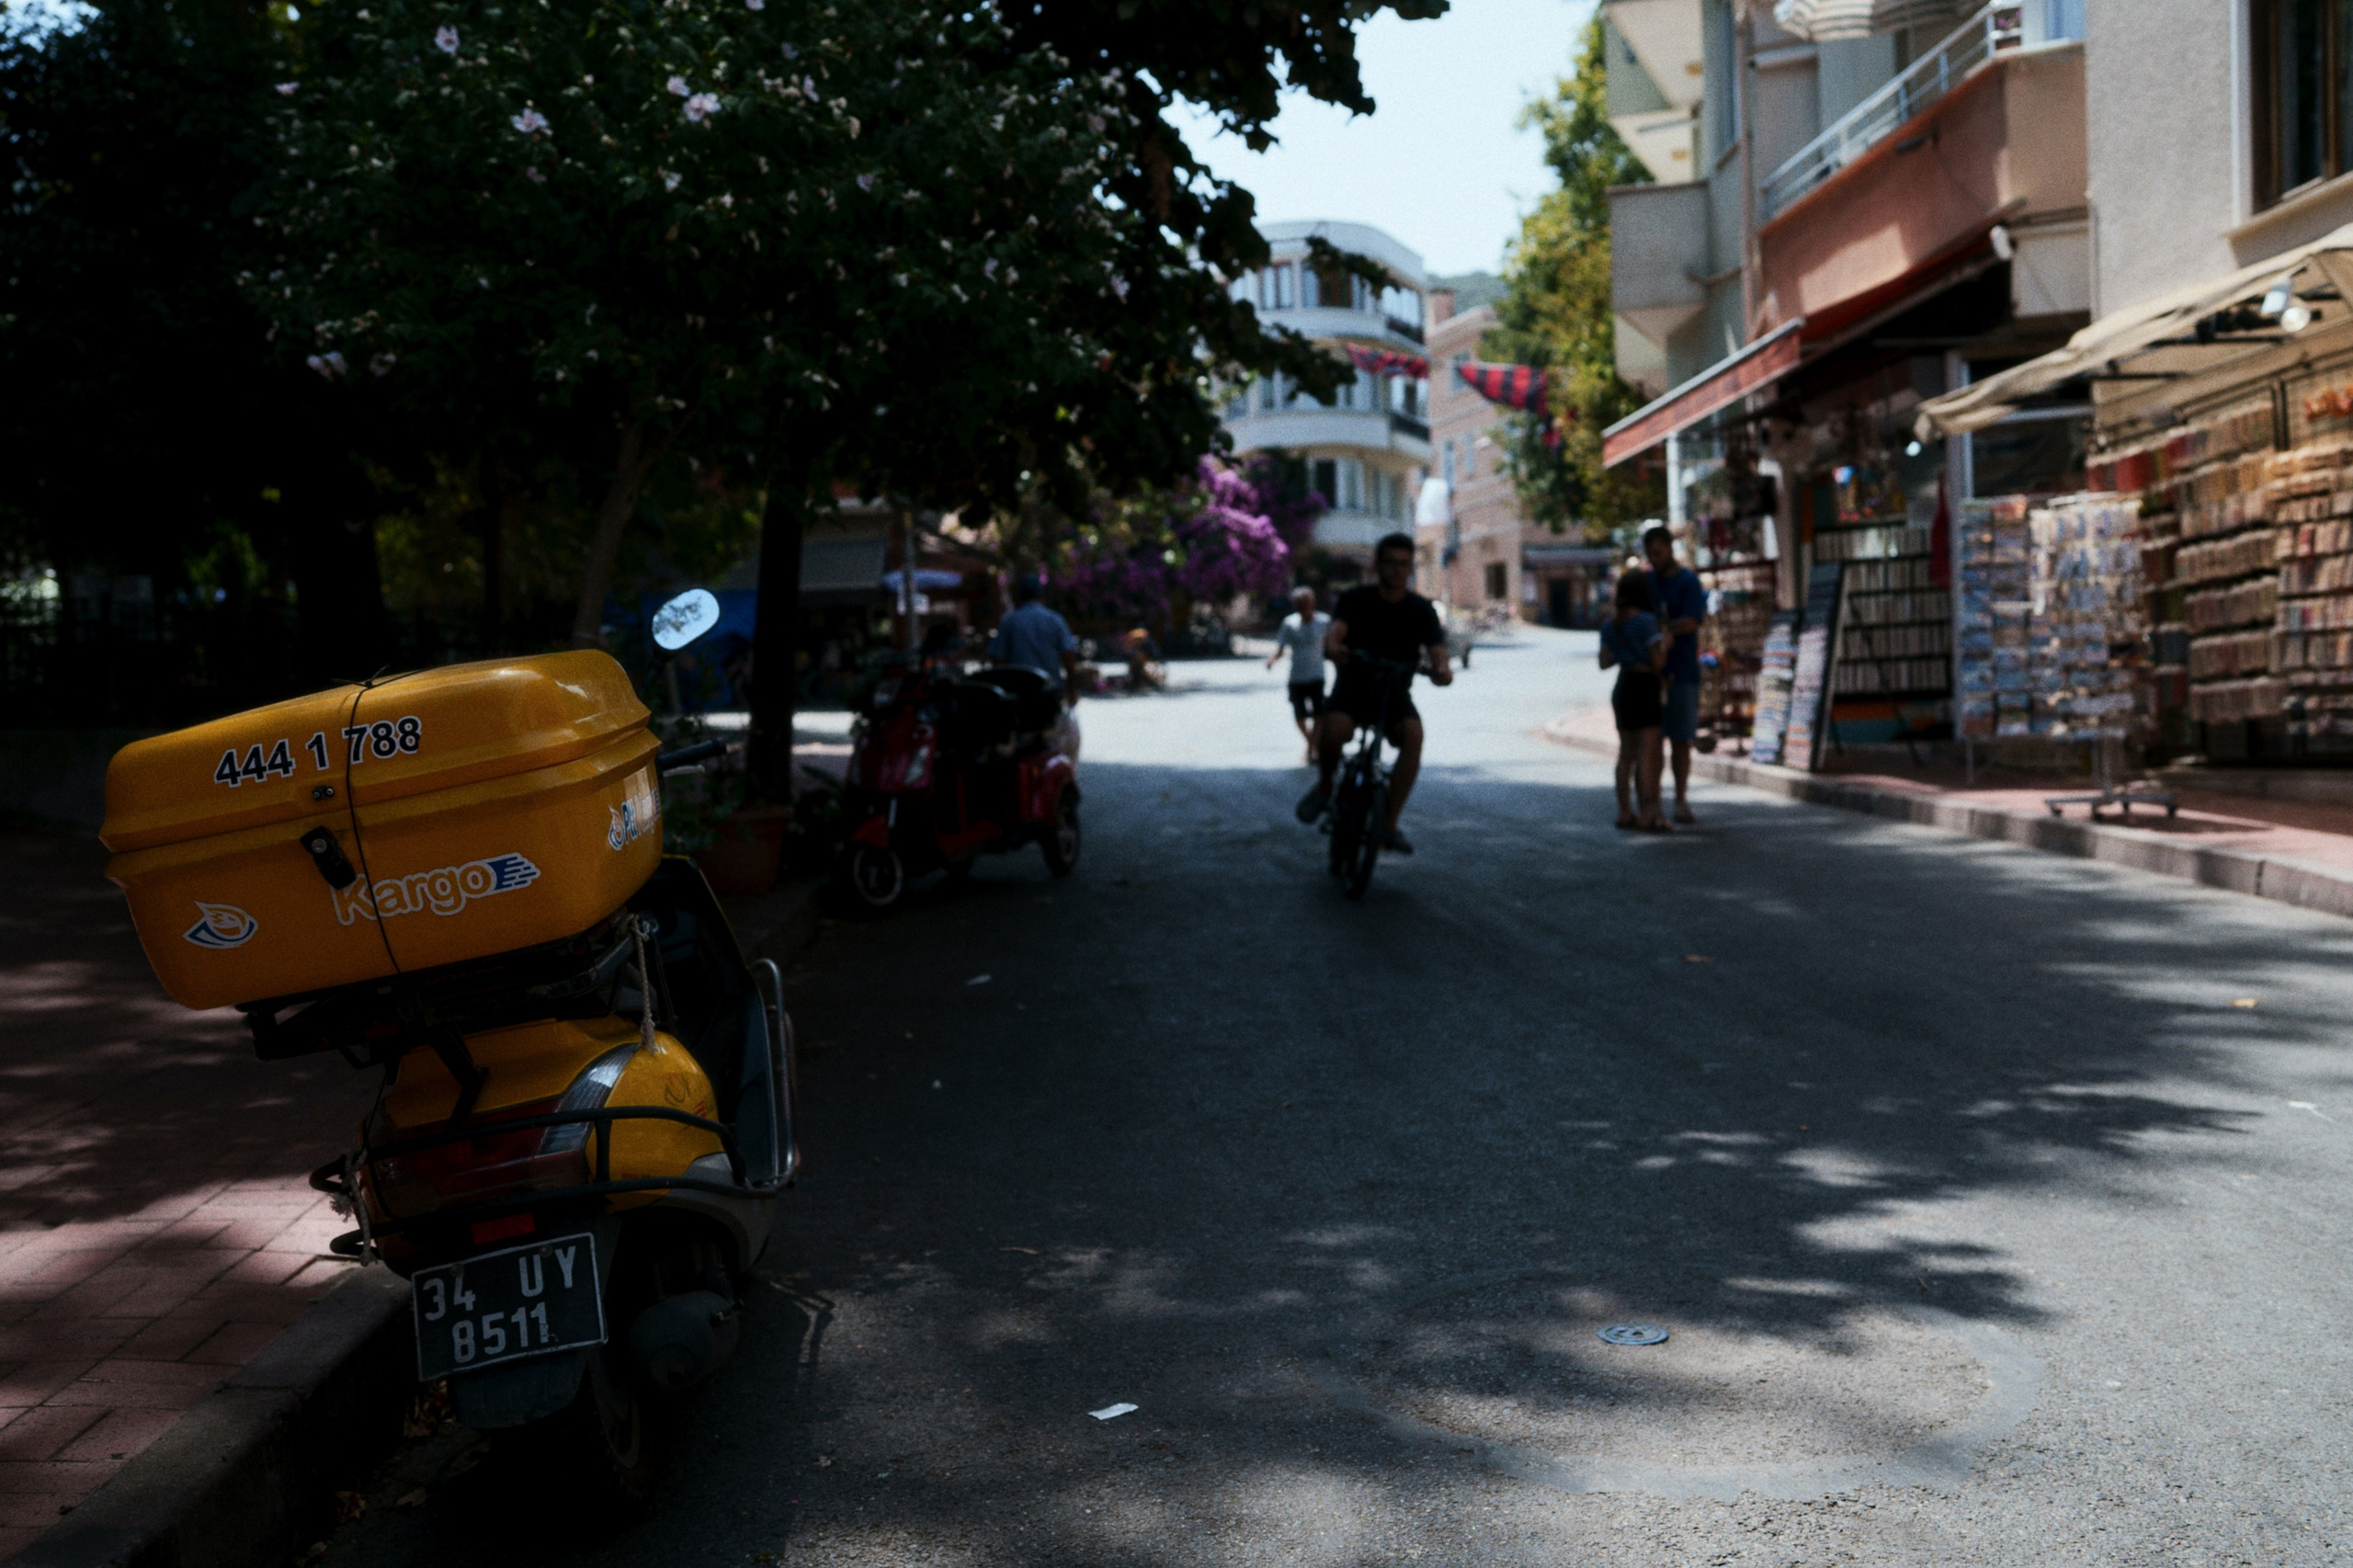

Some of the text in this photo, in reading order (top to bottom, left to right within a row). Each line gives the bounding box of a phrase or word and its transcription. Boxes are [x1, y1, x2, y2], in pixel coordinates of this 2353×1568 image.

[214, 715, 422, 788] 444 1 788
[331, 862, 494, 925] Kargo
[423, 1245, 576, 1321] 34 UY
[452, 1301, 549, 1363] 8511
